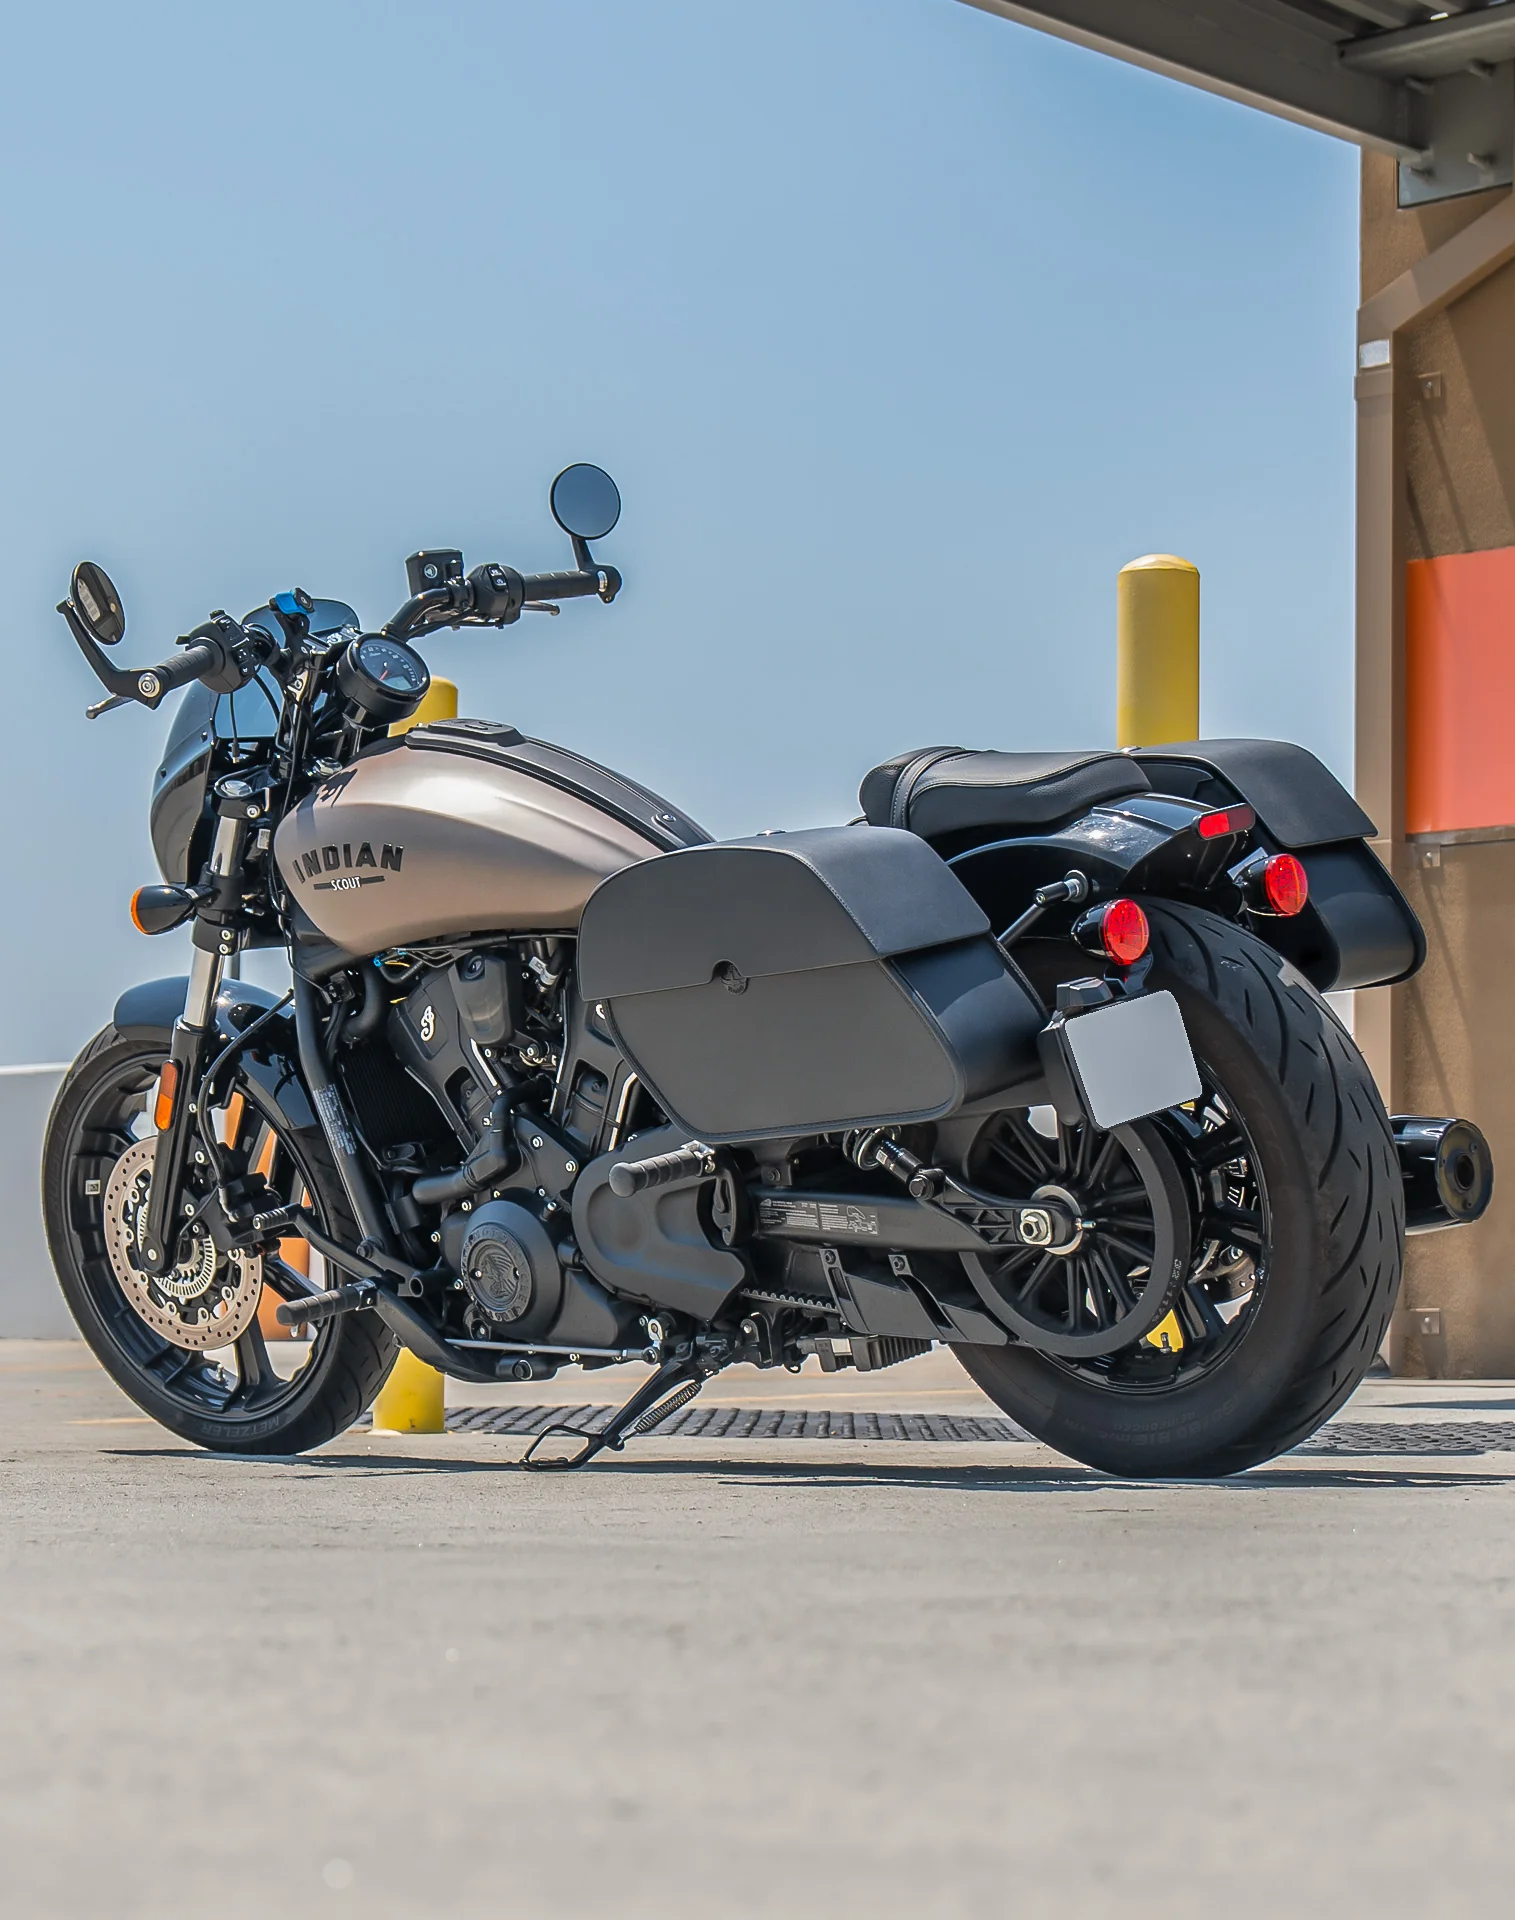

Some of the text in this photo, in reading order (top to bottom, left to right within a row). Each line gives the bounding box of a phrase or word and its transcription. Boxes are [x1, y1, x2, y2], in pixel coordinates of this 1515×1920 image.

[292, 841, 404, 884] INDIAN
[331, 876, 362, 891] SCOUT
[201, 1415, 280, 1438] METZELER
